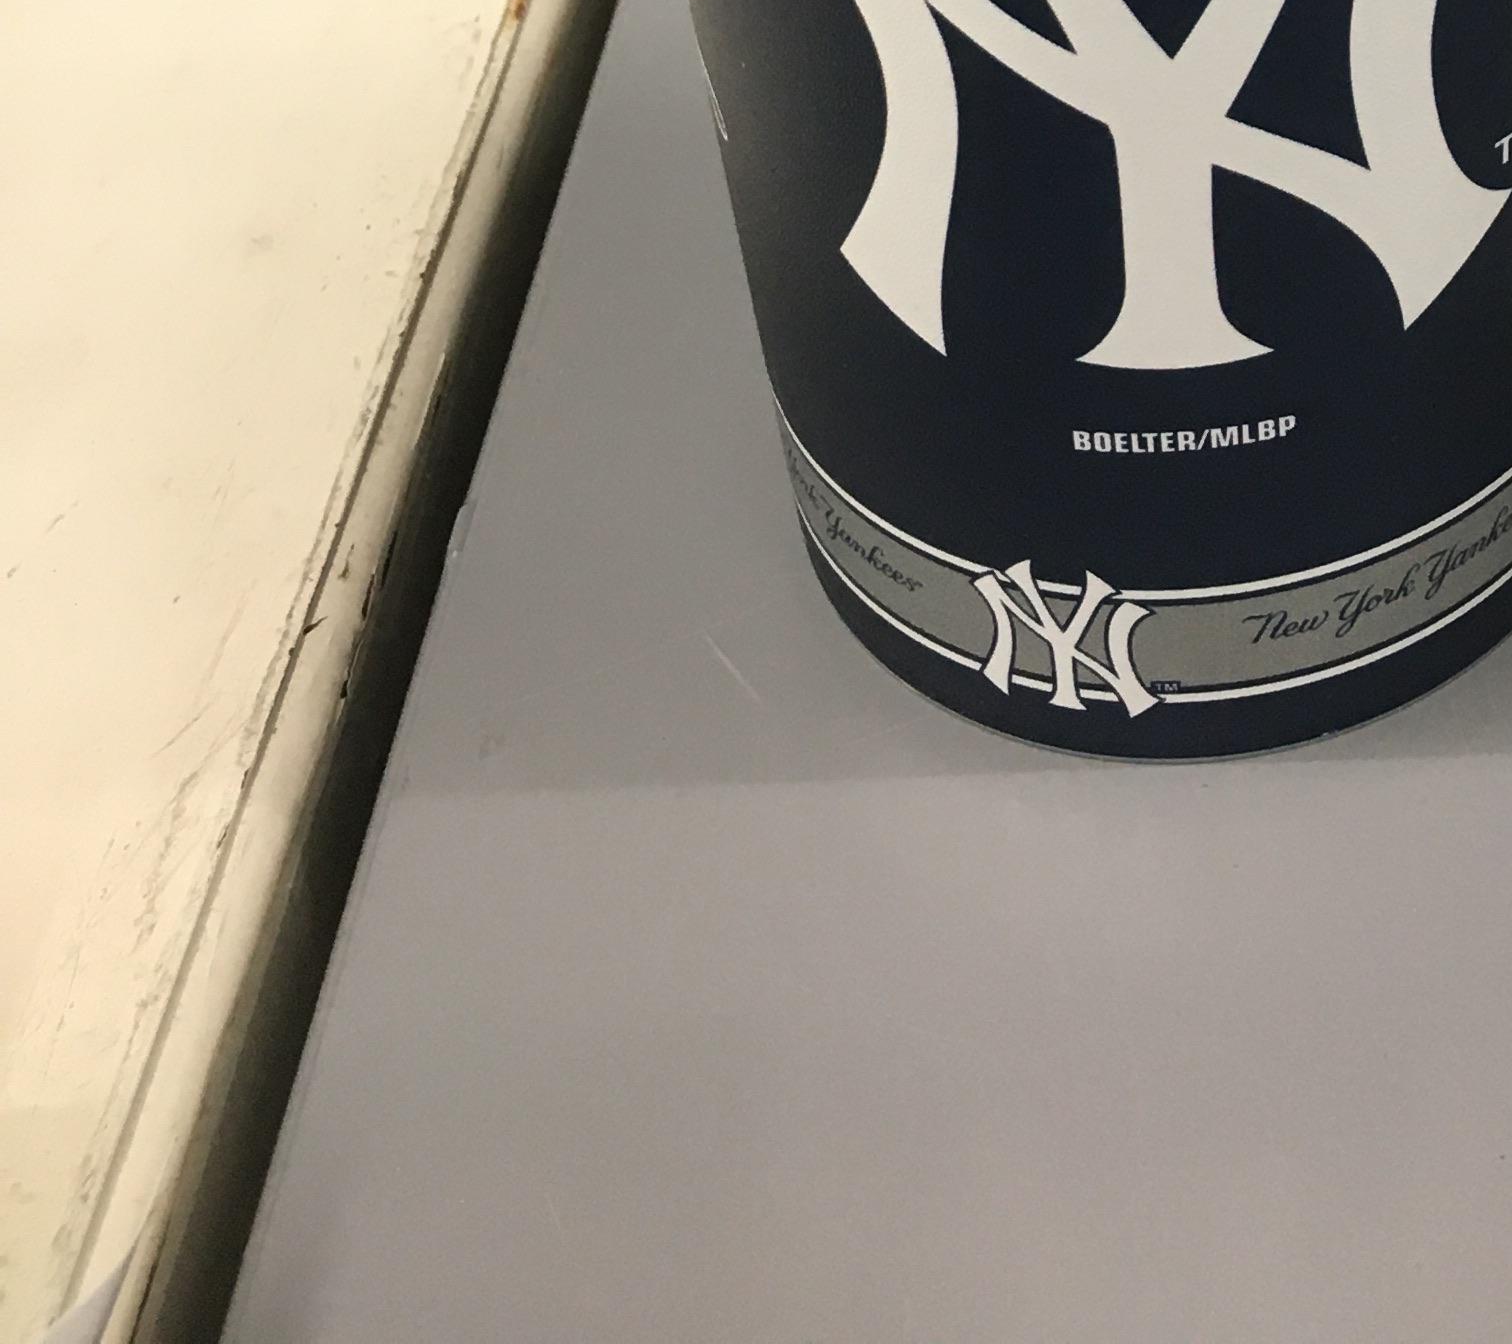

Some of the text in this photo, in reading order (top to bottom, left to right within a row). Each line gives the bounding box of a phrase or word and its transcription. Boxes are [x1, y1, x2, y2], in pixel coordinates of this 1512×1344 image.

[1071, 413, 1297, 454] BOELTER/MLBP
[819, 493, 918, 593] Yankees
[1241, 610, 1331, 645] New
[1332, 562, 1421, 639] York
